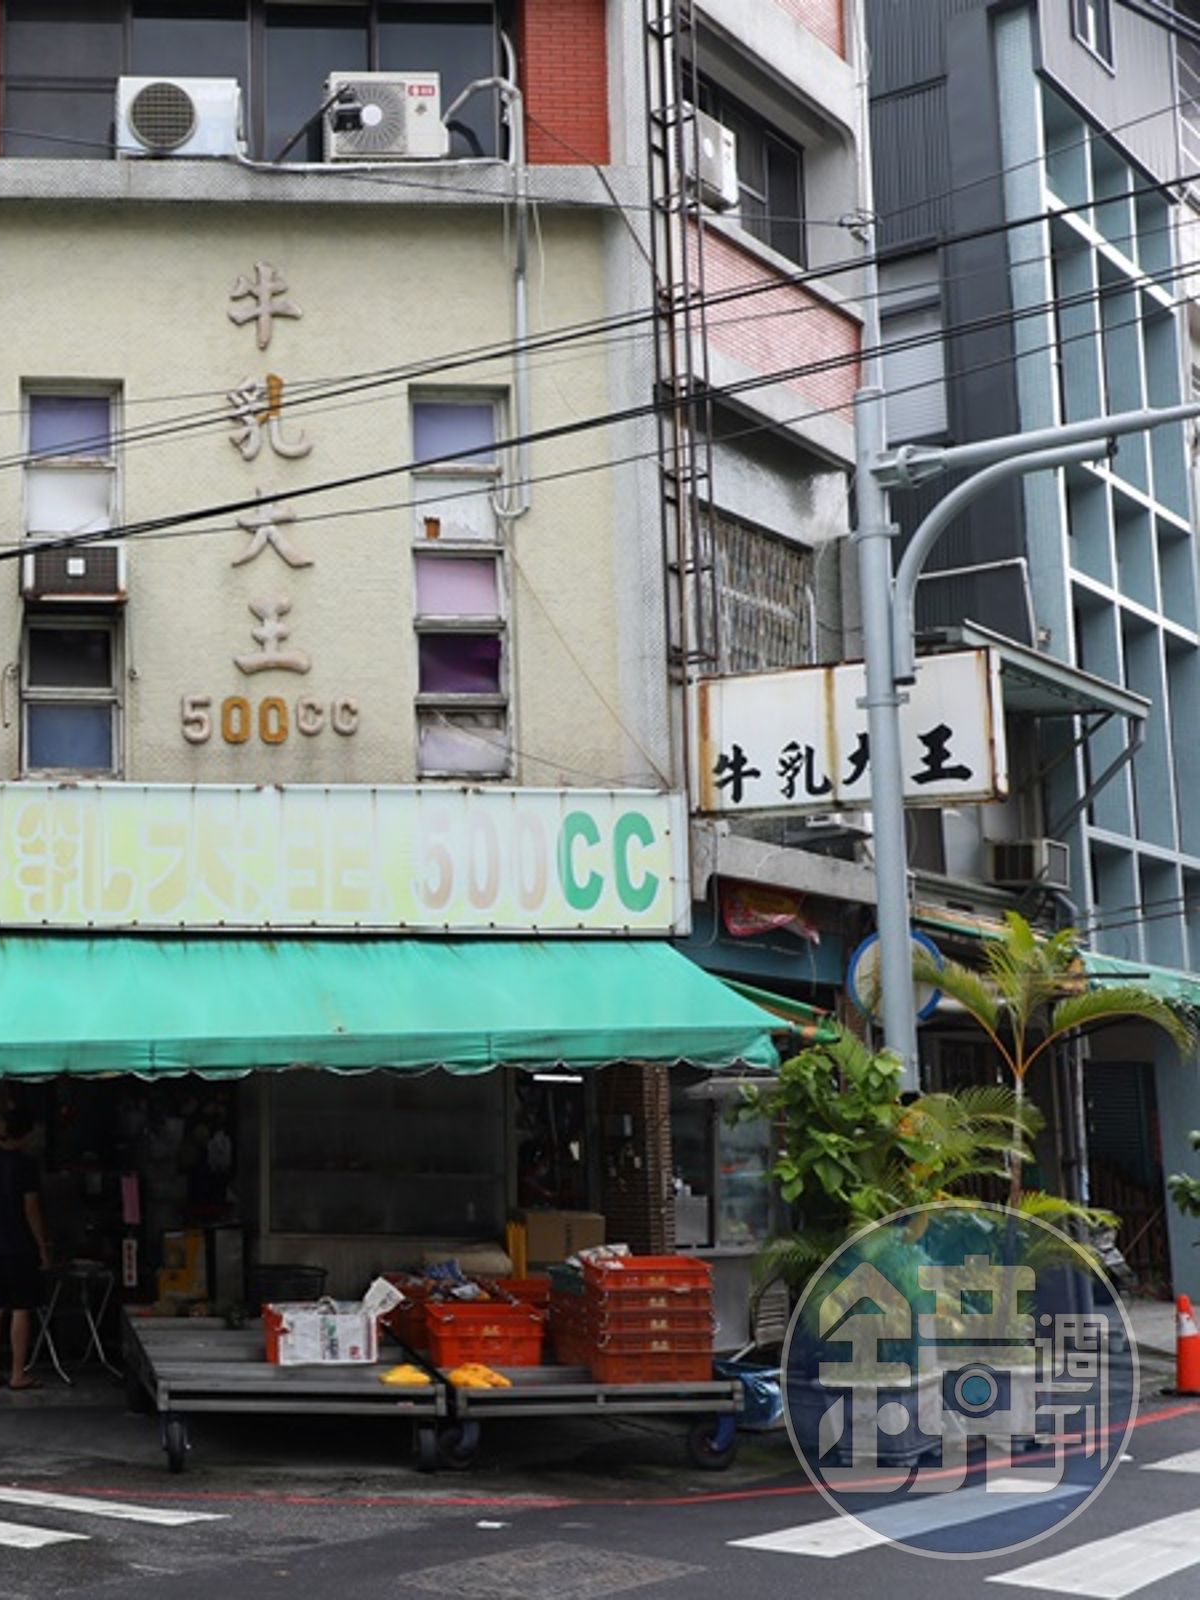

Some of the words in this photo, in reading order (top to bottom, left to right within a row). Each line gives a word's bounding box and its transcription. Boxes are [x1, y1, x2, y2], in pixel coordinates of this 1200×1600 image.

[227, 260, 314, 678] 牛乳大王
[415, 809, 660, 913] 500CC
